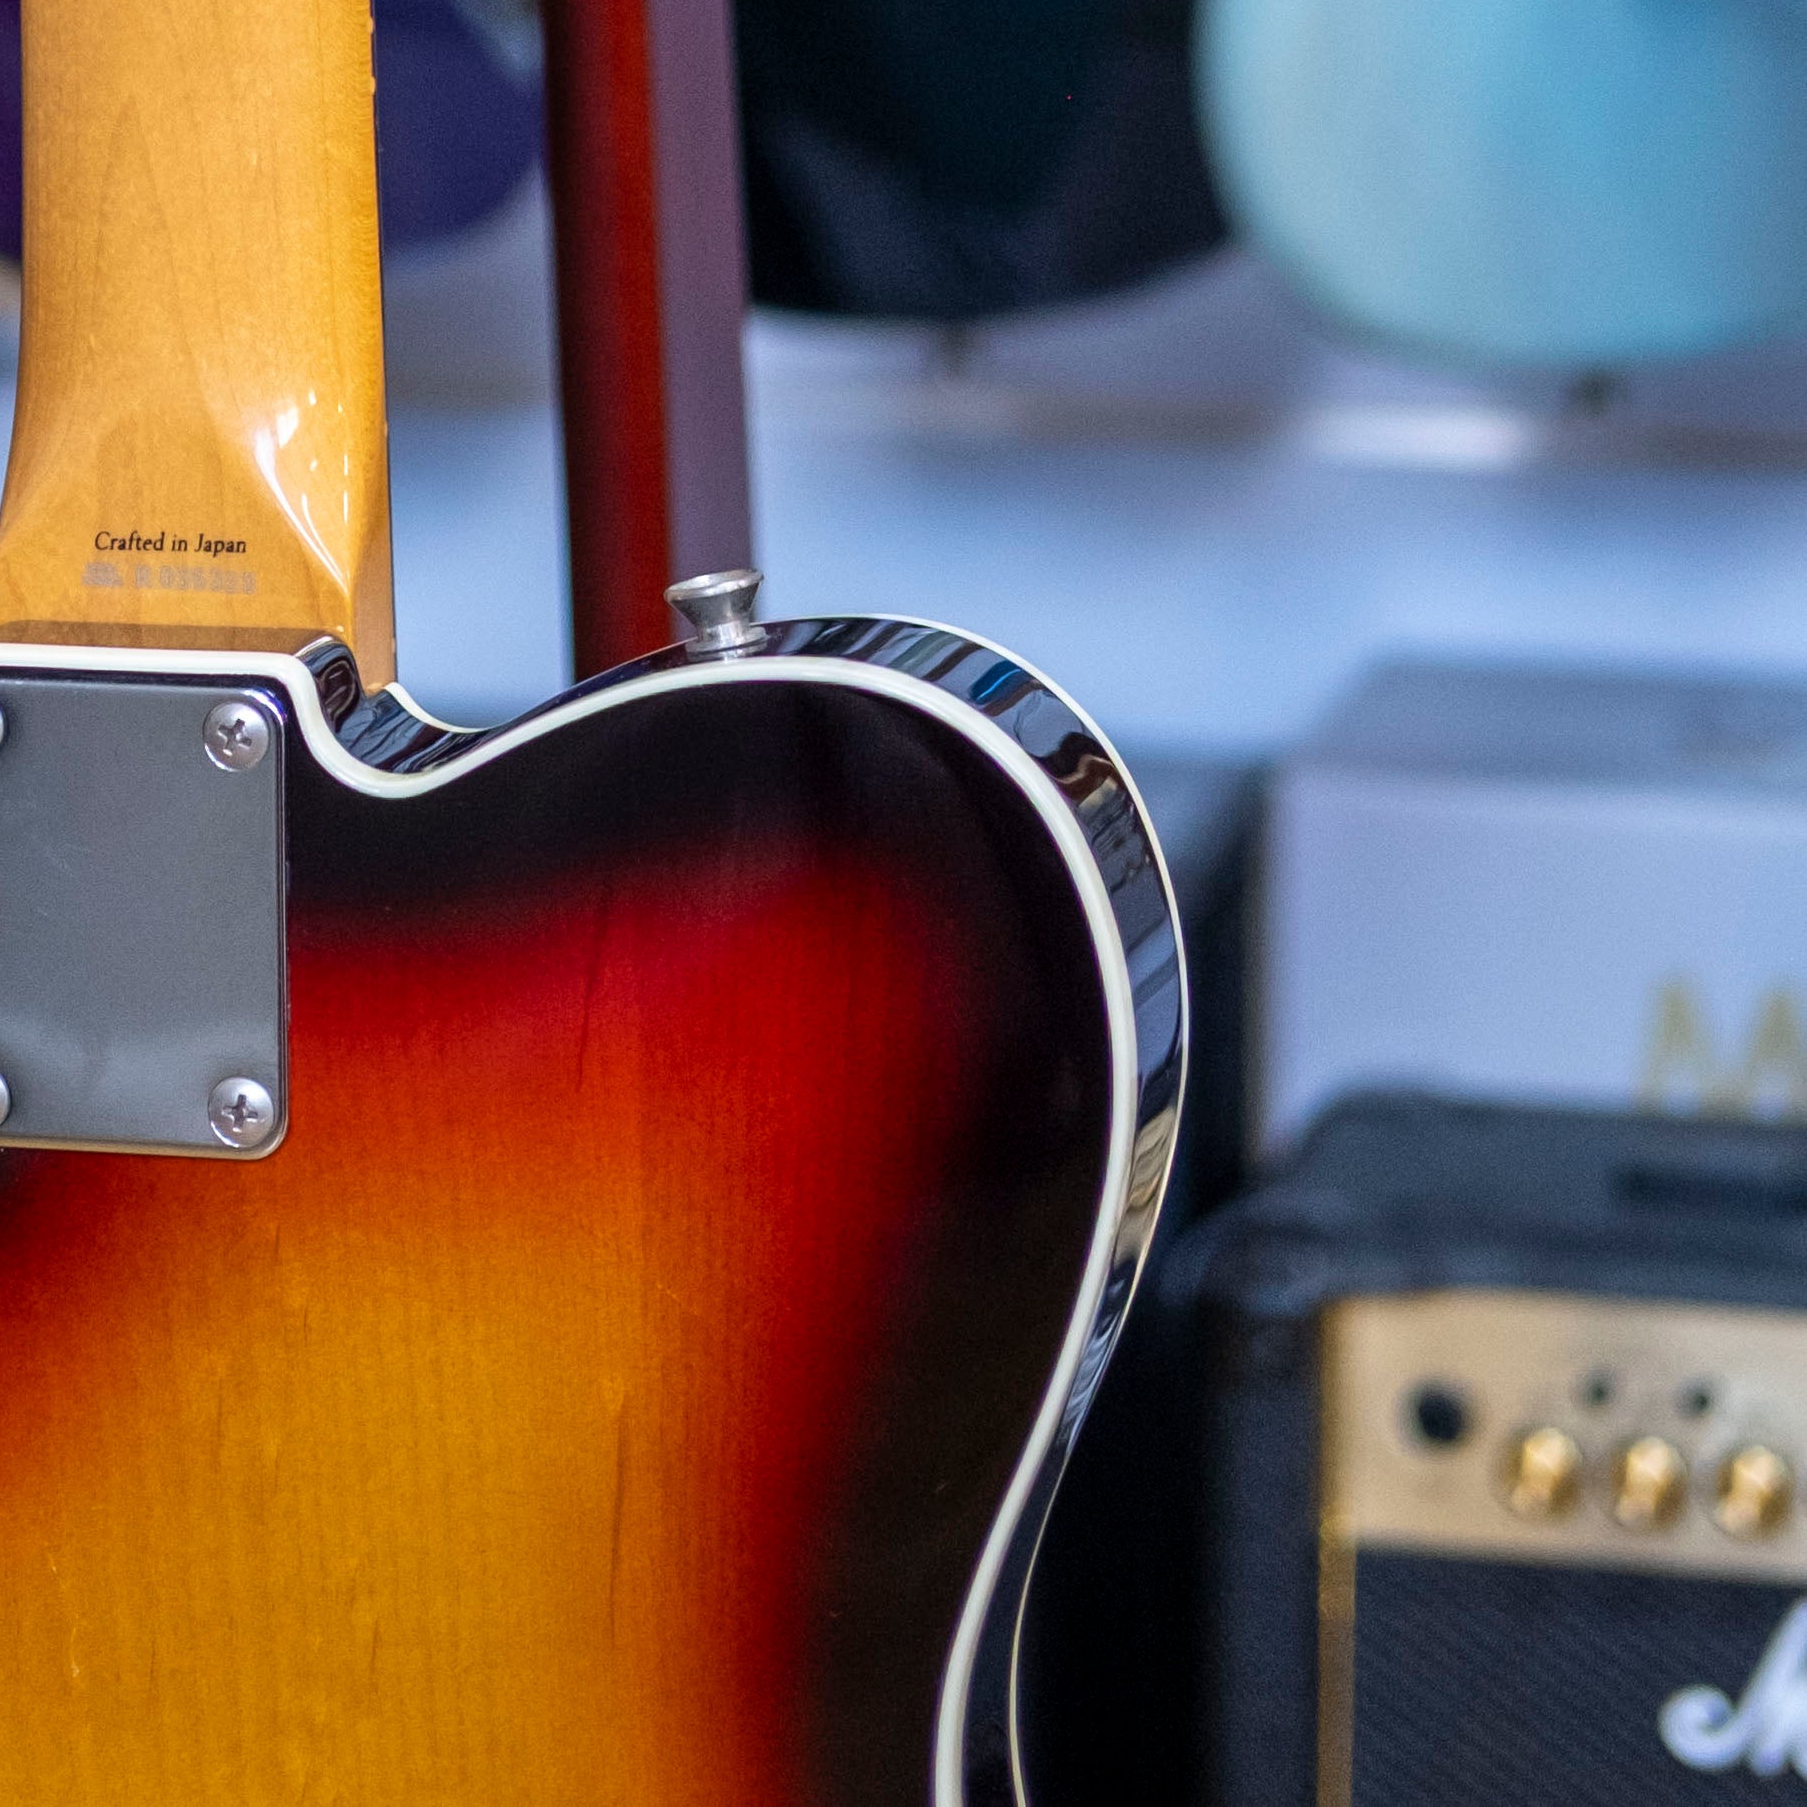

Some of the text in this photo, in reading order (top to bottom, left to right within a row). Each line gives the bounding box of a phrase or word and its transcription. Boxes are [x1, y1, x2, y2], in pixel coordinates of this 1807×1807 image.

[94, 530, 247, 558] Crafted in Japan
